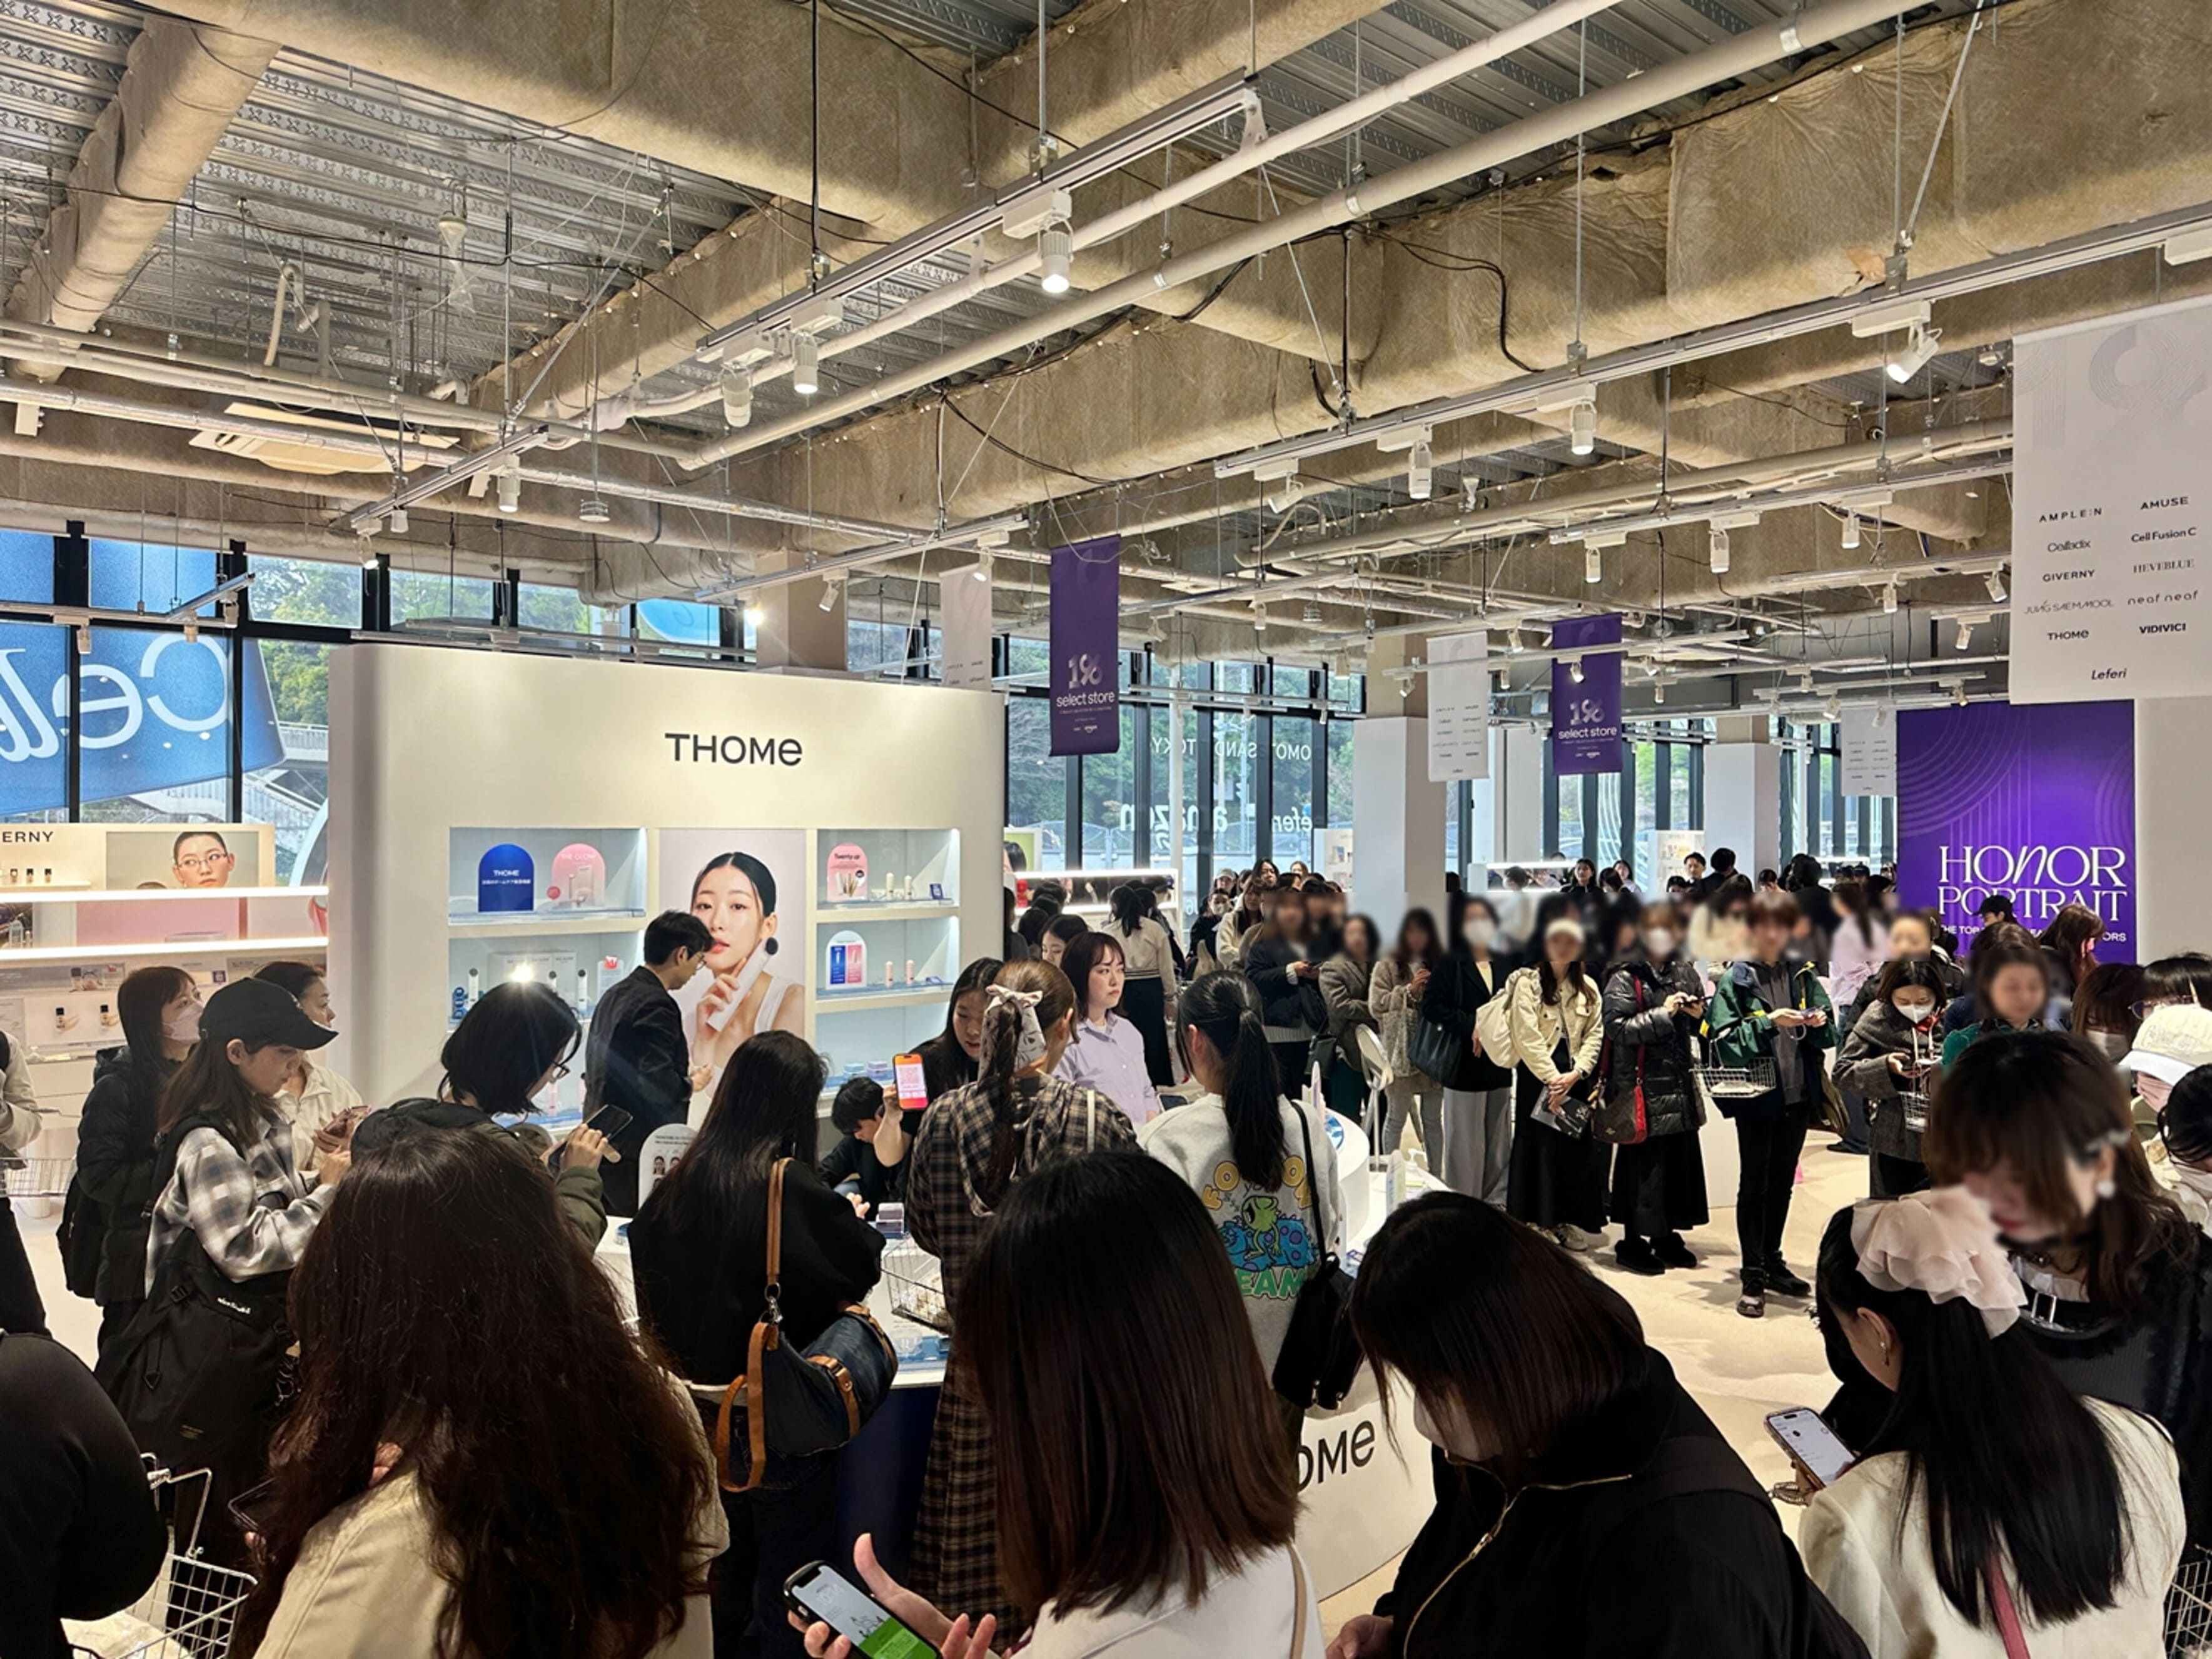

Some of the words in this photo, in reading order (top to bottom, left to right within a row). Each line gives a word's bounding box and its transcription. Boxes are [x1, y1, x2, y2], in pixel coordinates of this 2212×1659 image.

[2140, 496, 2189, 510] AMUSE
[2131, 533, 2150, 543] Cell
[2152, 530, 2186, 541] Fusion
[2188, 527, 2197, 537] C
[2133, 559, 2195, 573] HEVEBLUE
[2042, 569, 2095, 582] GIVERNY
[2139, 623, 2187, 634] VIDIVICI
[2091, 668, 2127, 680] Leferi
[1056, 692, 1087, 708] select
[1088, 691, 1115, 705] store
[1558, 727, 1588, 739] select
[1590, 727, 1618, 737] store
